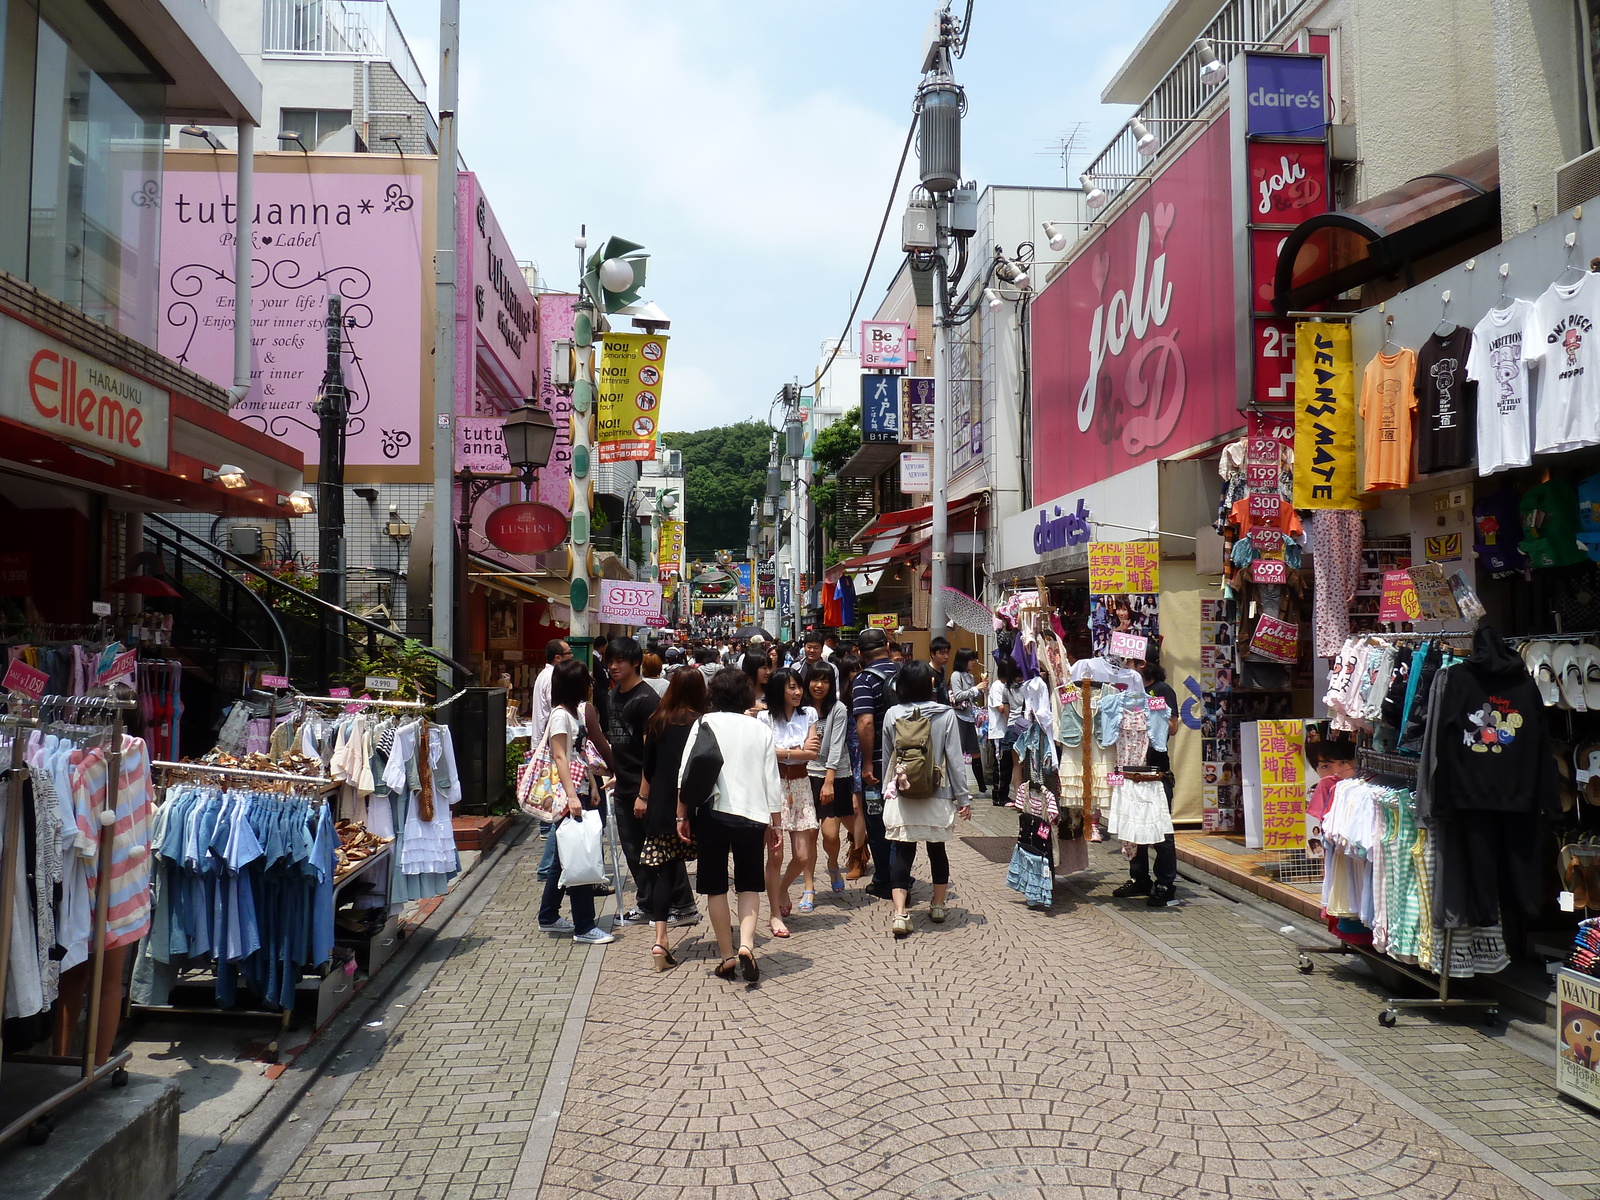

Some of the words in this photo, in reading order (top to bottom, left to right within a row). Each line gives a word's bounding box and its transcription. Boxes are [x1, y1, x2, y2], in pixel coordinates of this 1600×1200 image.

[1248, 86, 1321, 109] claire's
[1258, 156, 1305, 214] joli
[219, 232, 261, 250] Pik
[275, 232, 321, 247] Label
[259, 299, 289, 311] your
[250, 319, 270, 327] our
[273, 316, 306, 328] inner
[1077, 211, 1173, 433] joli
[1547, 321, 1566, 344] ONE
[1568, 313, 1594, 334] PIECE
[872, 329, 892, 341] Be
[272, 334, 305, 349] socks
[604, 342, 629, 352] NO!!
[872, 341, 901, 353] Bee
[1262, 326, 1296, 357] 2F
[263, 352, 276, 363] &
[866, 354, 880, 363] 3F
[270, 368, 304, 379] inner
[601, 367, 627, 377] NO!!
[88, 367, 142, 405] HARAJUKU
[263, 383, 276, 395] &
[29, 349, 143, 448] Elleme
[600, 393, 624, 402] NO!!
[874, 378, 898, 431] 大戸屋
[599, 419, 621, 429] NO!!
[463, 427, 503, 441] tutu
[599, 429, 632, 438] shoplifting
[1250, 440, 1276, 452] ¥99
[1248, 468, 1277, 480] ¥199
[1250, 497, 1280, 509] ¥300
[1252, 530, 1282, 543] ¥499
[1089, 544, 1122, 554] アイドル
[1125, 543, 1157, 555] 当ビル
[1090, 555, 1122, 566] 生写真
[1090, 567, 1124, 577] ポスター
[1253, 563, 1284, 575] ¥699
[1091, 579, 1123, 592] ガチャ
[609, 587, 655, 607] SBY
[602, 605, 631, 616] Happy
[632, 607, 658, 617] Room
[1259, 722, 1301, 737] 当ビル
[1263, 787, 1304, 798] アイドル
[1264, 801, 1303, 815] 生写真
[1264, 817, 1305, 828] ポスター
[1265, 831, 1304, 847] ガチャ
[1561, 979, 1600, 1011] WANT
